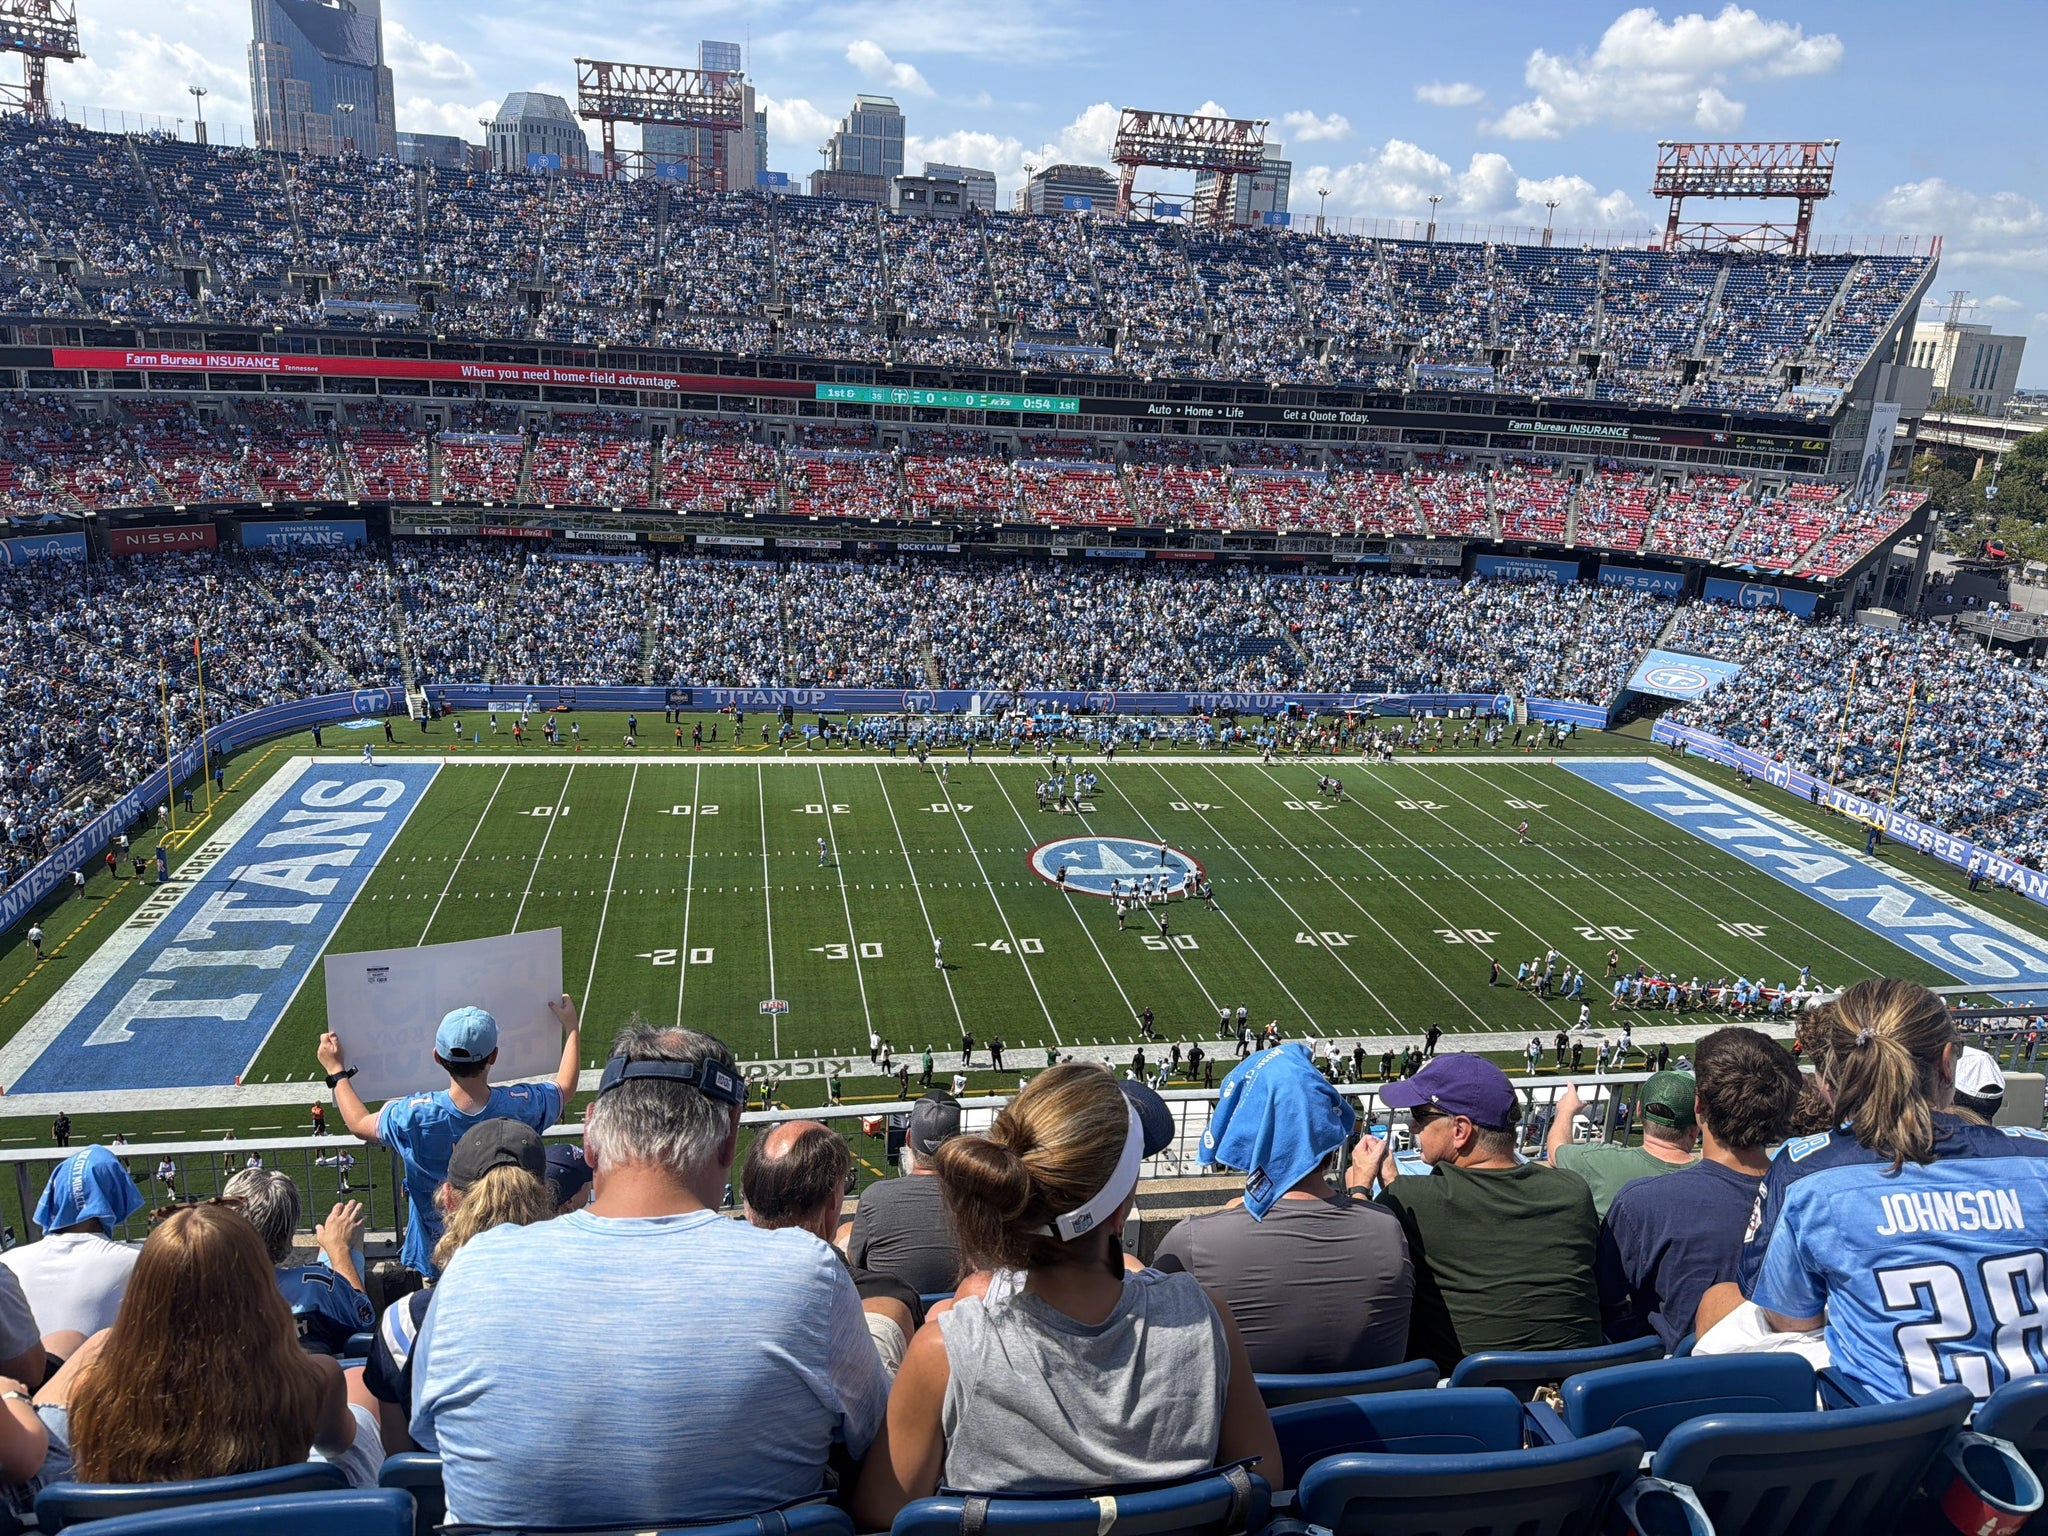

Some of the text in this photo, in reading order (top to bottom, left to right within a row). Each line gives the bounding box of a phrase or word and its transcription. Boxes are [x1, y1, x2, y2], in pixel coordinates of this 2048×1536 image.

[1261, 183, 1275, 191] UBS
[126, 353, 318, 372] Farm Bureau INSURANCE Tennessee
[461, 365, 680, 390] When you need home-field advantage.
[828, 388, 845, 398] 1st
[926, 393, 934, 404] 0
[965, 395, 974, 406] 0
[1023, 398, 1075, 410] 0:54 1st
[1148, 404, 1244, 418] Auto Home Life
[1283, 409, 1299, 420] Get
[1309, 411, 1337, 422] Quote
[1339, 412, 1369, 424] Today.
[1508, 420, 1661, 441] Farm Bureau INSURANCE Tennessee
[126, 530, 204, 545] NISSAN
[266, 533, 345, 548] TITANS
[572, 531, 632, 541] Tennessean.
[41, 541, 83, 558] Kroger
[857, 541, 879, 549] FedEx
[897, 543, 925, 551] ROCKY
[1494, 566, 1559, 580] TITANS
[1505, 561, 1548, 569] TENNESSEE
[1604, 573, 1677, 591] NISSAN
[1658, 659, 1727, 674] NISSAN
[711, 690, 826, 705] TITAN UP
[1184, 694, 1287, 709] TITAN UP
[671, 804, 719, 816] 20
[805, 804, 851, 815] 30
[930, 803, 974, 814] 40
[1171, 801, 1215, 811] 40
[1283, 800, 1330, 811] 30
[1395, 800, 1440, 810] 20
[88, 793, 141, 852] TITANS
[1833, 790, 2048, 899] TENNESSEE TITAN
[126, 841, 231, 928] NEVER FORGET
[1611, 775, 2048, 979] TITANS
[1898, 875, 1932, 890] OF
[1935, 891, 1971, 910] US
[82, 778, 406, 1046] TITANS
[1433, 929, 1496, 945] 30
[1573, 926, 1635, 942] 20
[1716, 922, 1769, 938] 10
[988, 938, 1045, 955] 40
[1140, 934, 1200, 951] 50
[1295, 931, 1352, 947] 40
[652, 948, 715, 966] 20
[825, 942, 884, 960] 30
[736, 1059, 852, 1078] KICKO
[73, 1159, 86, 1175] CITY
[72, 1176, 87, 1210] MIRACLE
[1877, 1189, 2025, 1236] JOHNSON
[1873, 1248, 2048, 1401] 28
